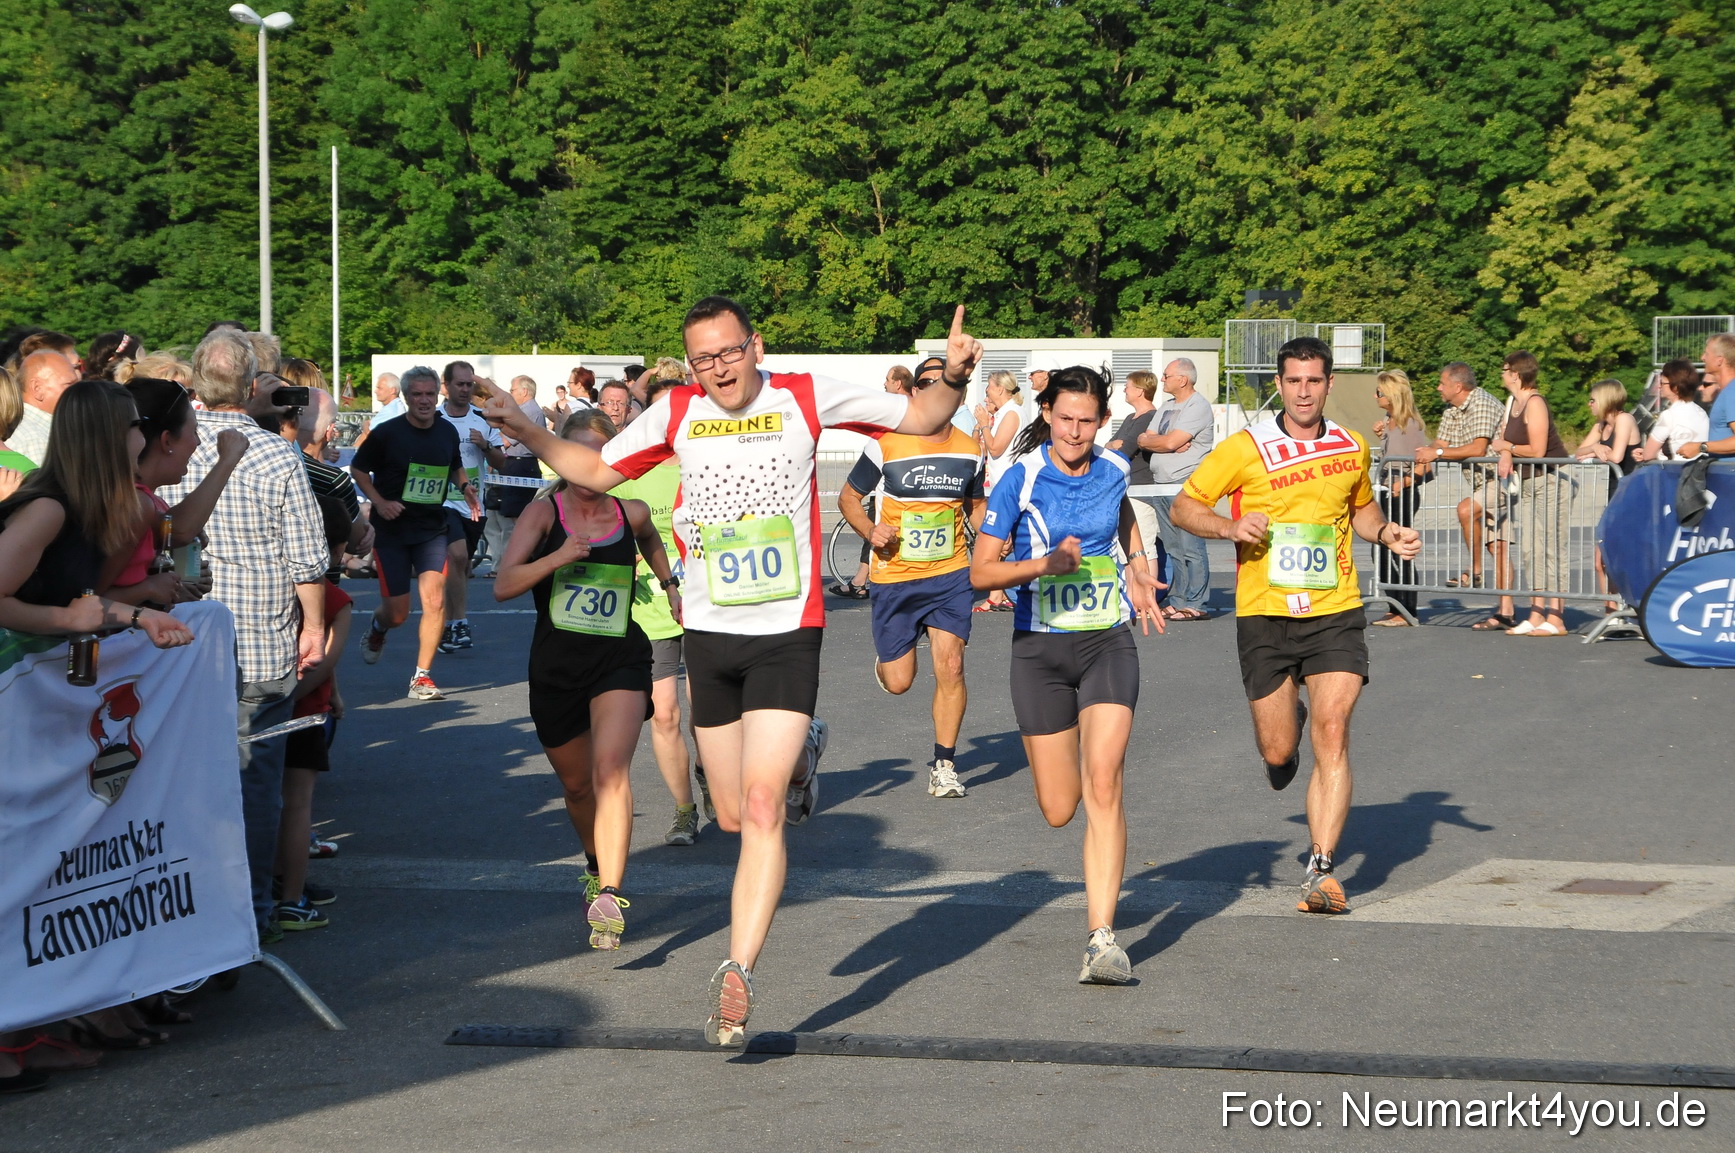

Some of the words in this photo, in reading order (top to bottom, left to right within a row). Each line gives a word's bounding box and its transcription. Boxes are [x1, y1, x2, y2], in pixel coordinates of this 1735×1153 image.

[693, 416, 773, 435] ONLINE
[738, 434, 783, 444] Germany
[407, 477, 444, 495] 1181
[914, 474, 964, 486] Fischer
[919, 484, 961, 492] AUTOMOBILE
[1269, 467, 1317, 491] MAX
[1320, 459, 1361, 478] BÖGL
[908, 528, 947, 549] 375
[718, 546, 782, 584] 910
[1279, 545, 1328, 573] 809
[564, 584, 618, 618] 730
[1042, 581, 1115, 613] 1037
[1701, 602, 1735, 629] Fi
[47, 819, 165, 889] Neumarkter
[23, 862, 196, 968] Lammsbräu
